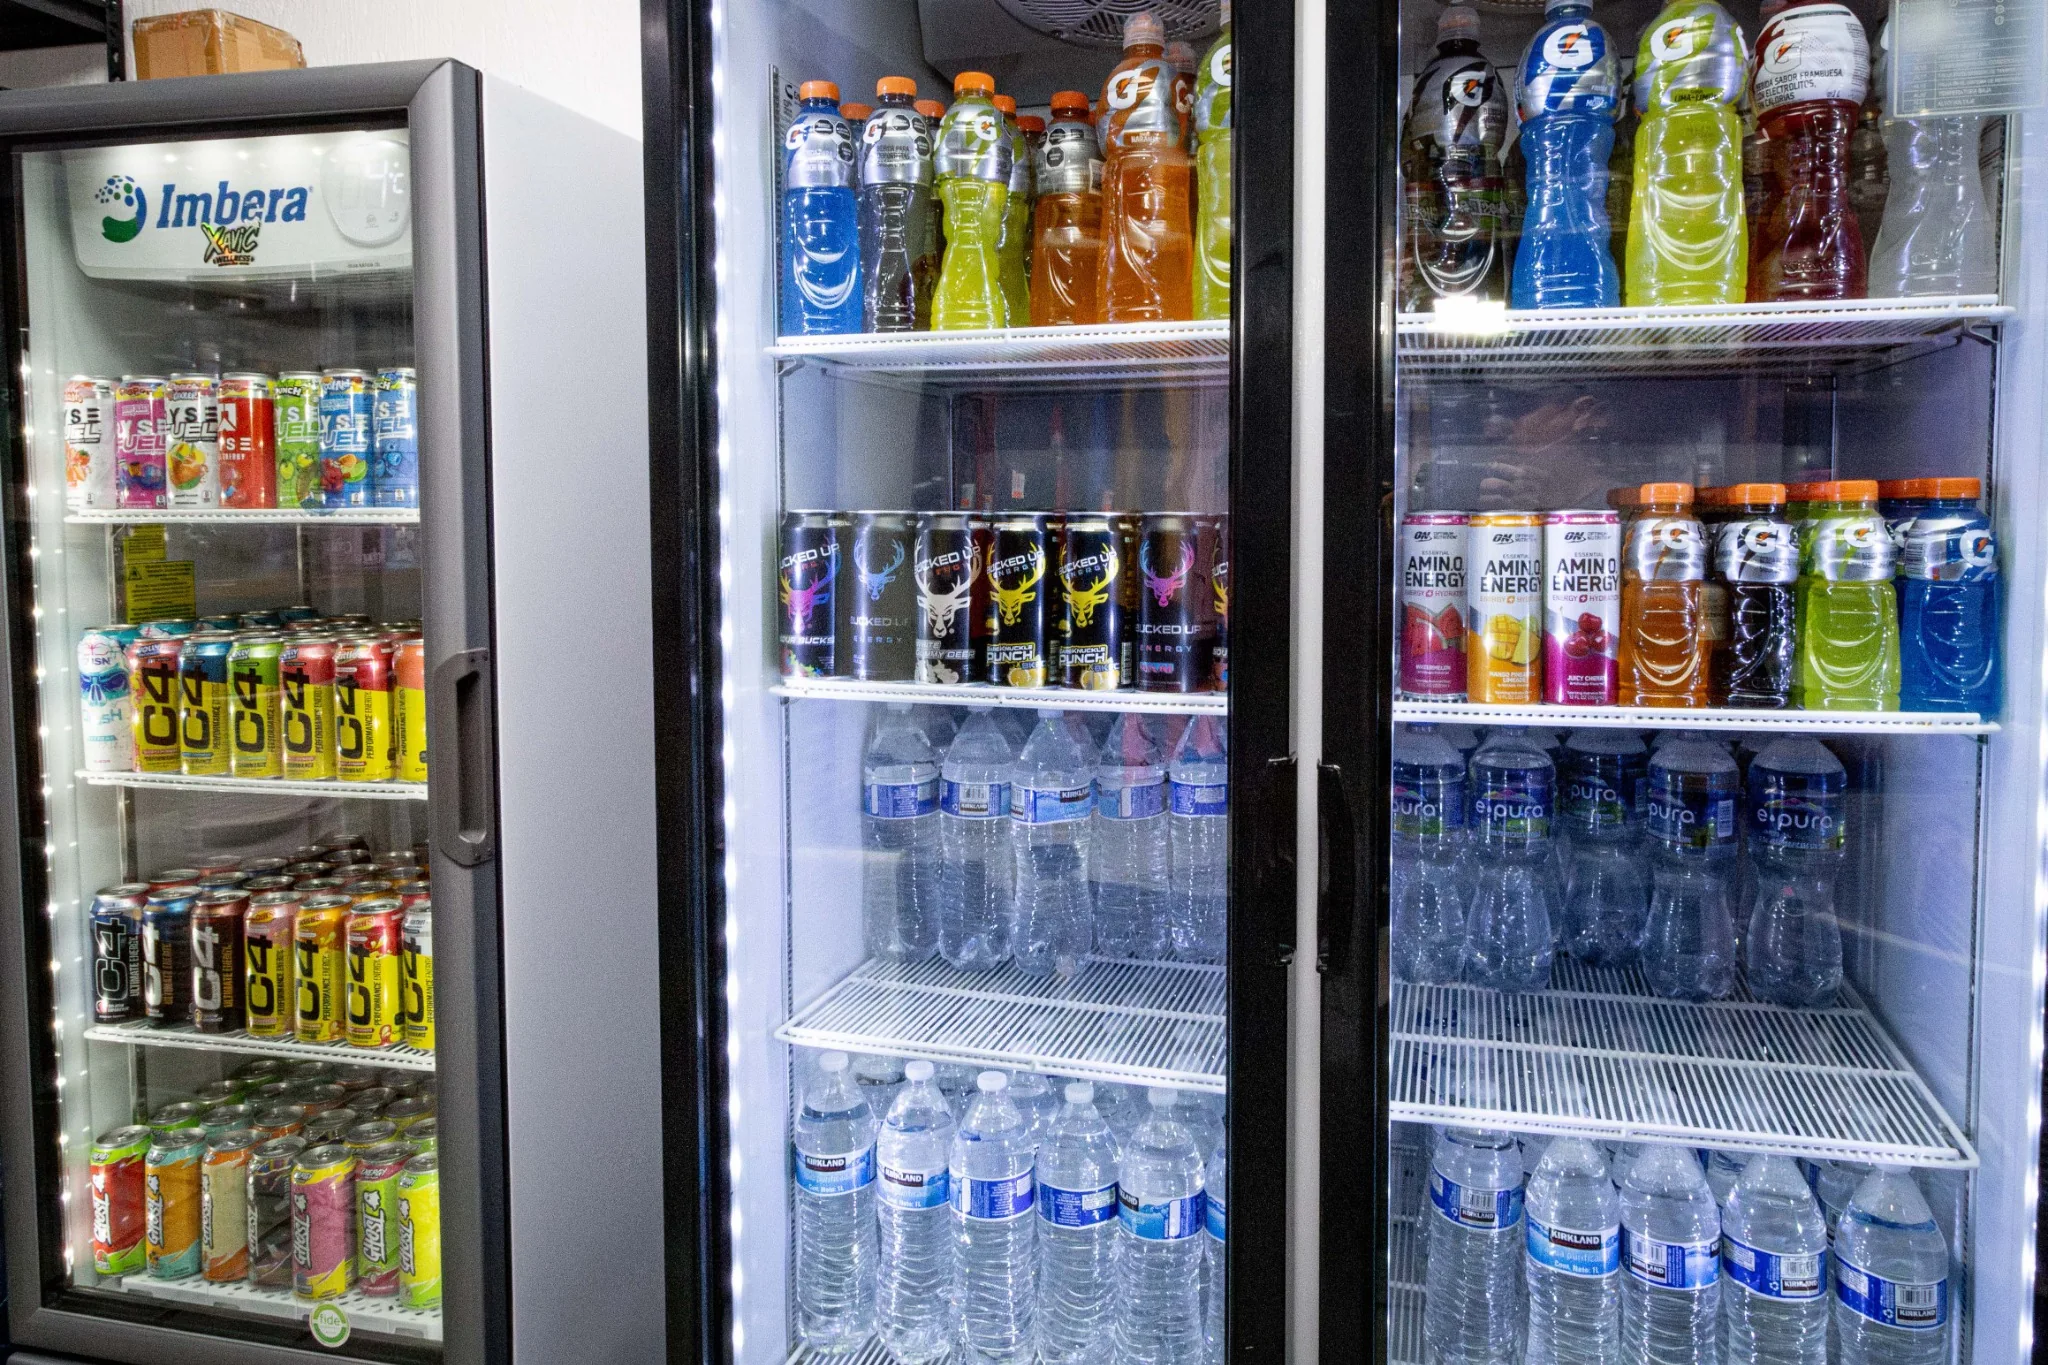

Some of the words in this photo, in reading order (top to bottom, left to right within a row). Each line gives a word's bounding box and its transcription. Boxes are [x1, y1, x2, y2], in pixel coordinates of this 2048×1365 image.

[1775, 73, 1798, 86] SABOR
[1800, 69, 1843, 79] FRAMBUESA
[156, 181, 309, 229] Imbera
[1405, 572, 1466, 588] ENERGY
[1480, 577, 1542, 593] ENERGY
[1553, 576, 1619, 592] ENERGY
[947, 651, 976, 660] DEER
[142, 663, 177, 747] C4
[181, 662, 210, 750] C4
[234, 668, 265, 753] C4
[283, 668, 313, 754] C4
[336, 675, 364, 760] C4
[95, 918, 128, 1000] C4
[192, 926, 221, 1011] C4
[247, 934, 274, 1016] C4
[295, 939, 320, 1021] C4
[348, 943, 372, 1026] C4
[806, 1156, 845, 1167] KIRKLAND
[886, 1169, 923, 1183] KIRKLAND
[362, 1208, 387, 1264] GHOST
[1462, 1210, 1495, 1221] KIRKLAND
[1551, 1230, 1600, 1246] KIRKLAND
[293, 1214, 312, 1270] GHOST
[1593, 1266, 1599, 1274] 1L
[1784, 1279, 1818, 1290] KIRKLAND
[1899, 1308, 1936, 1318] KIRKLAND
